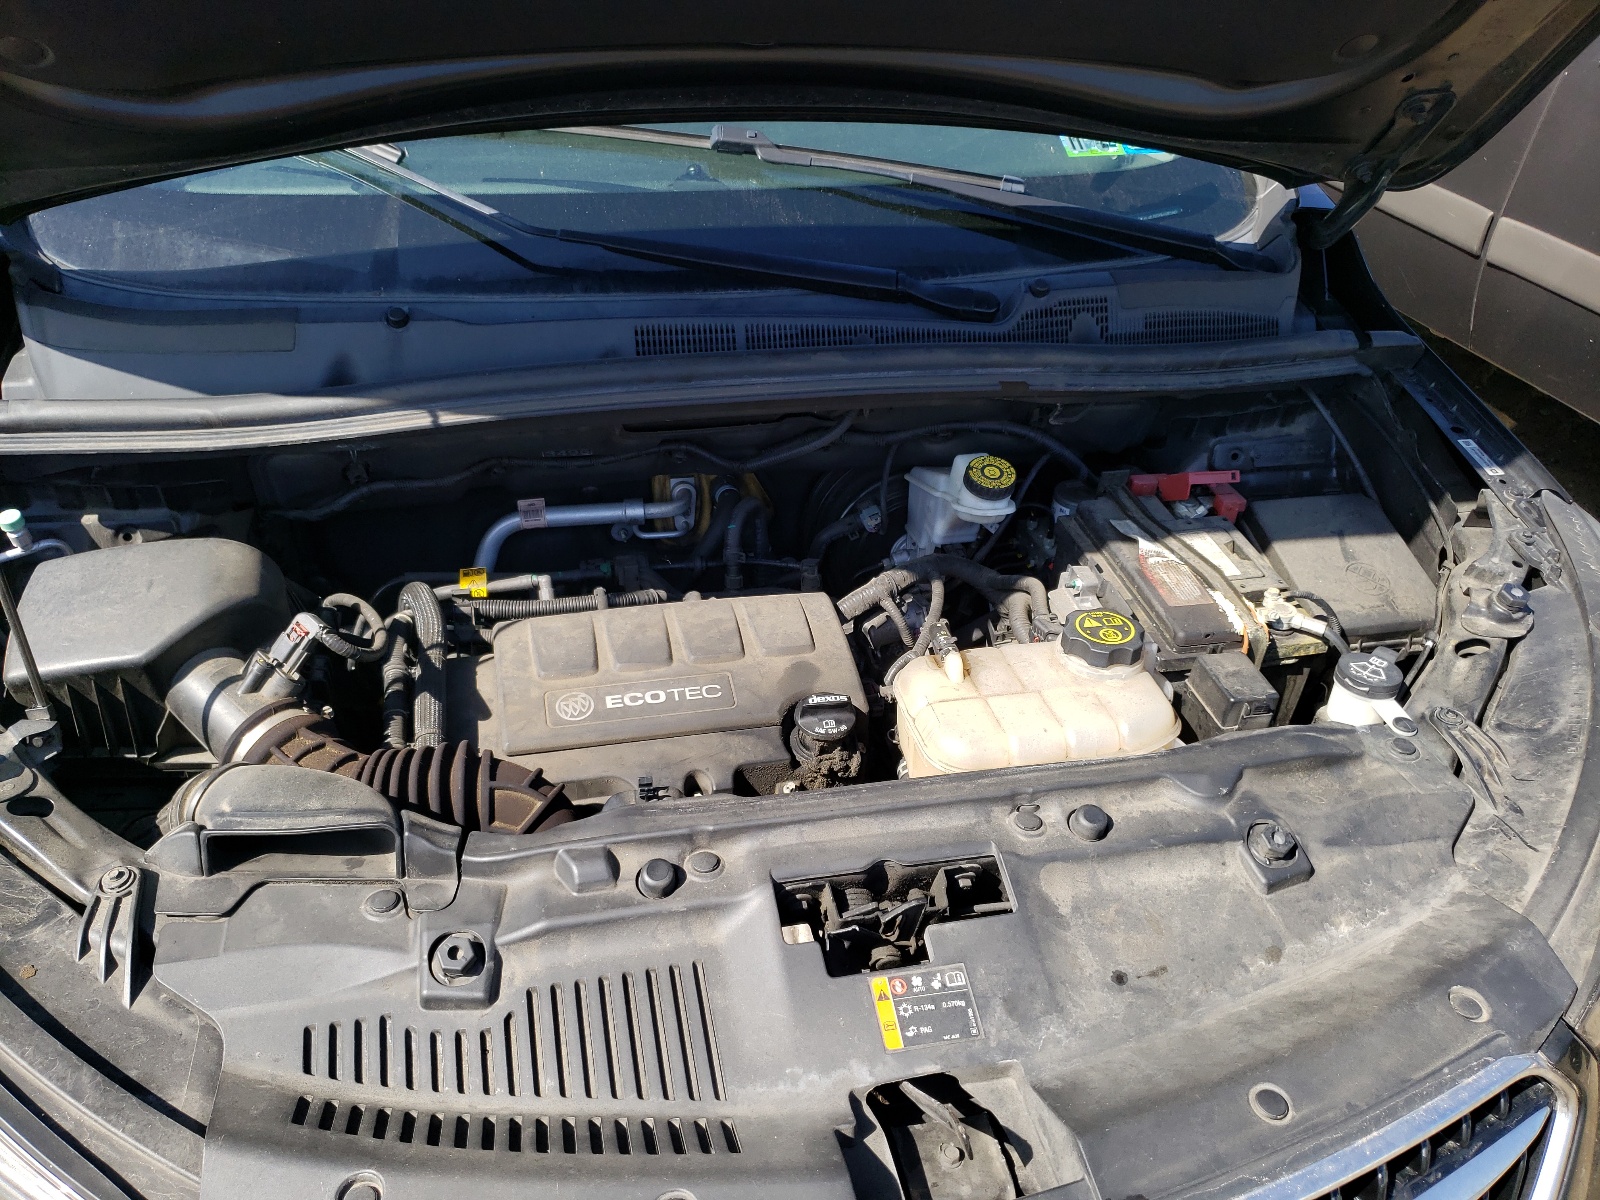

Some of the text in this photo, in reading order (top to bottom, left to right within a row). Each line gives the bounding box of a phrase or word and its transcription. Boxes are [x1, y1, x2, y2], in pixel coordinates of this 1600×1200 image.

[605, 684, 722, 708] ECOTEC
[808, 694, 848, 704] dexos
[814, 726, 827, 734] SAE
[913, 1003, 936, 1012] R-134a
[919, 1025, 933, 1034] PAG
